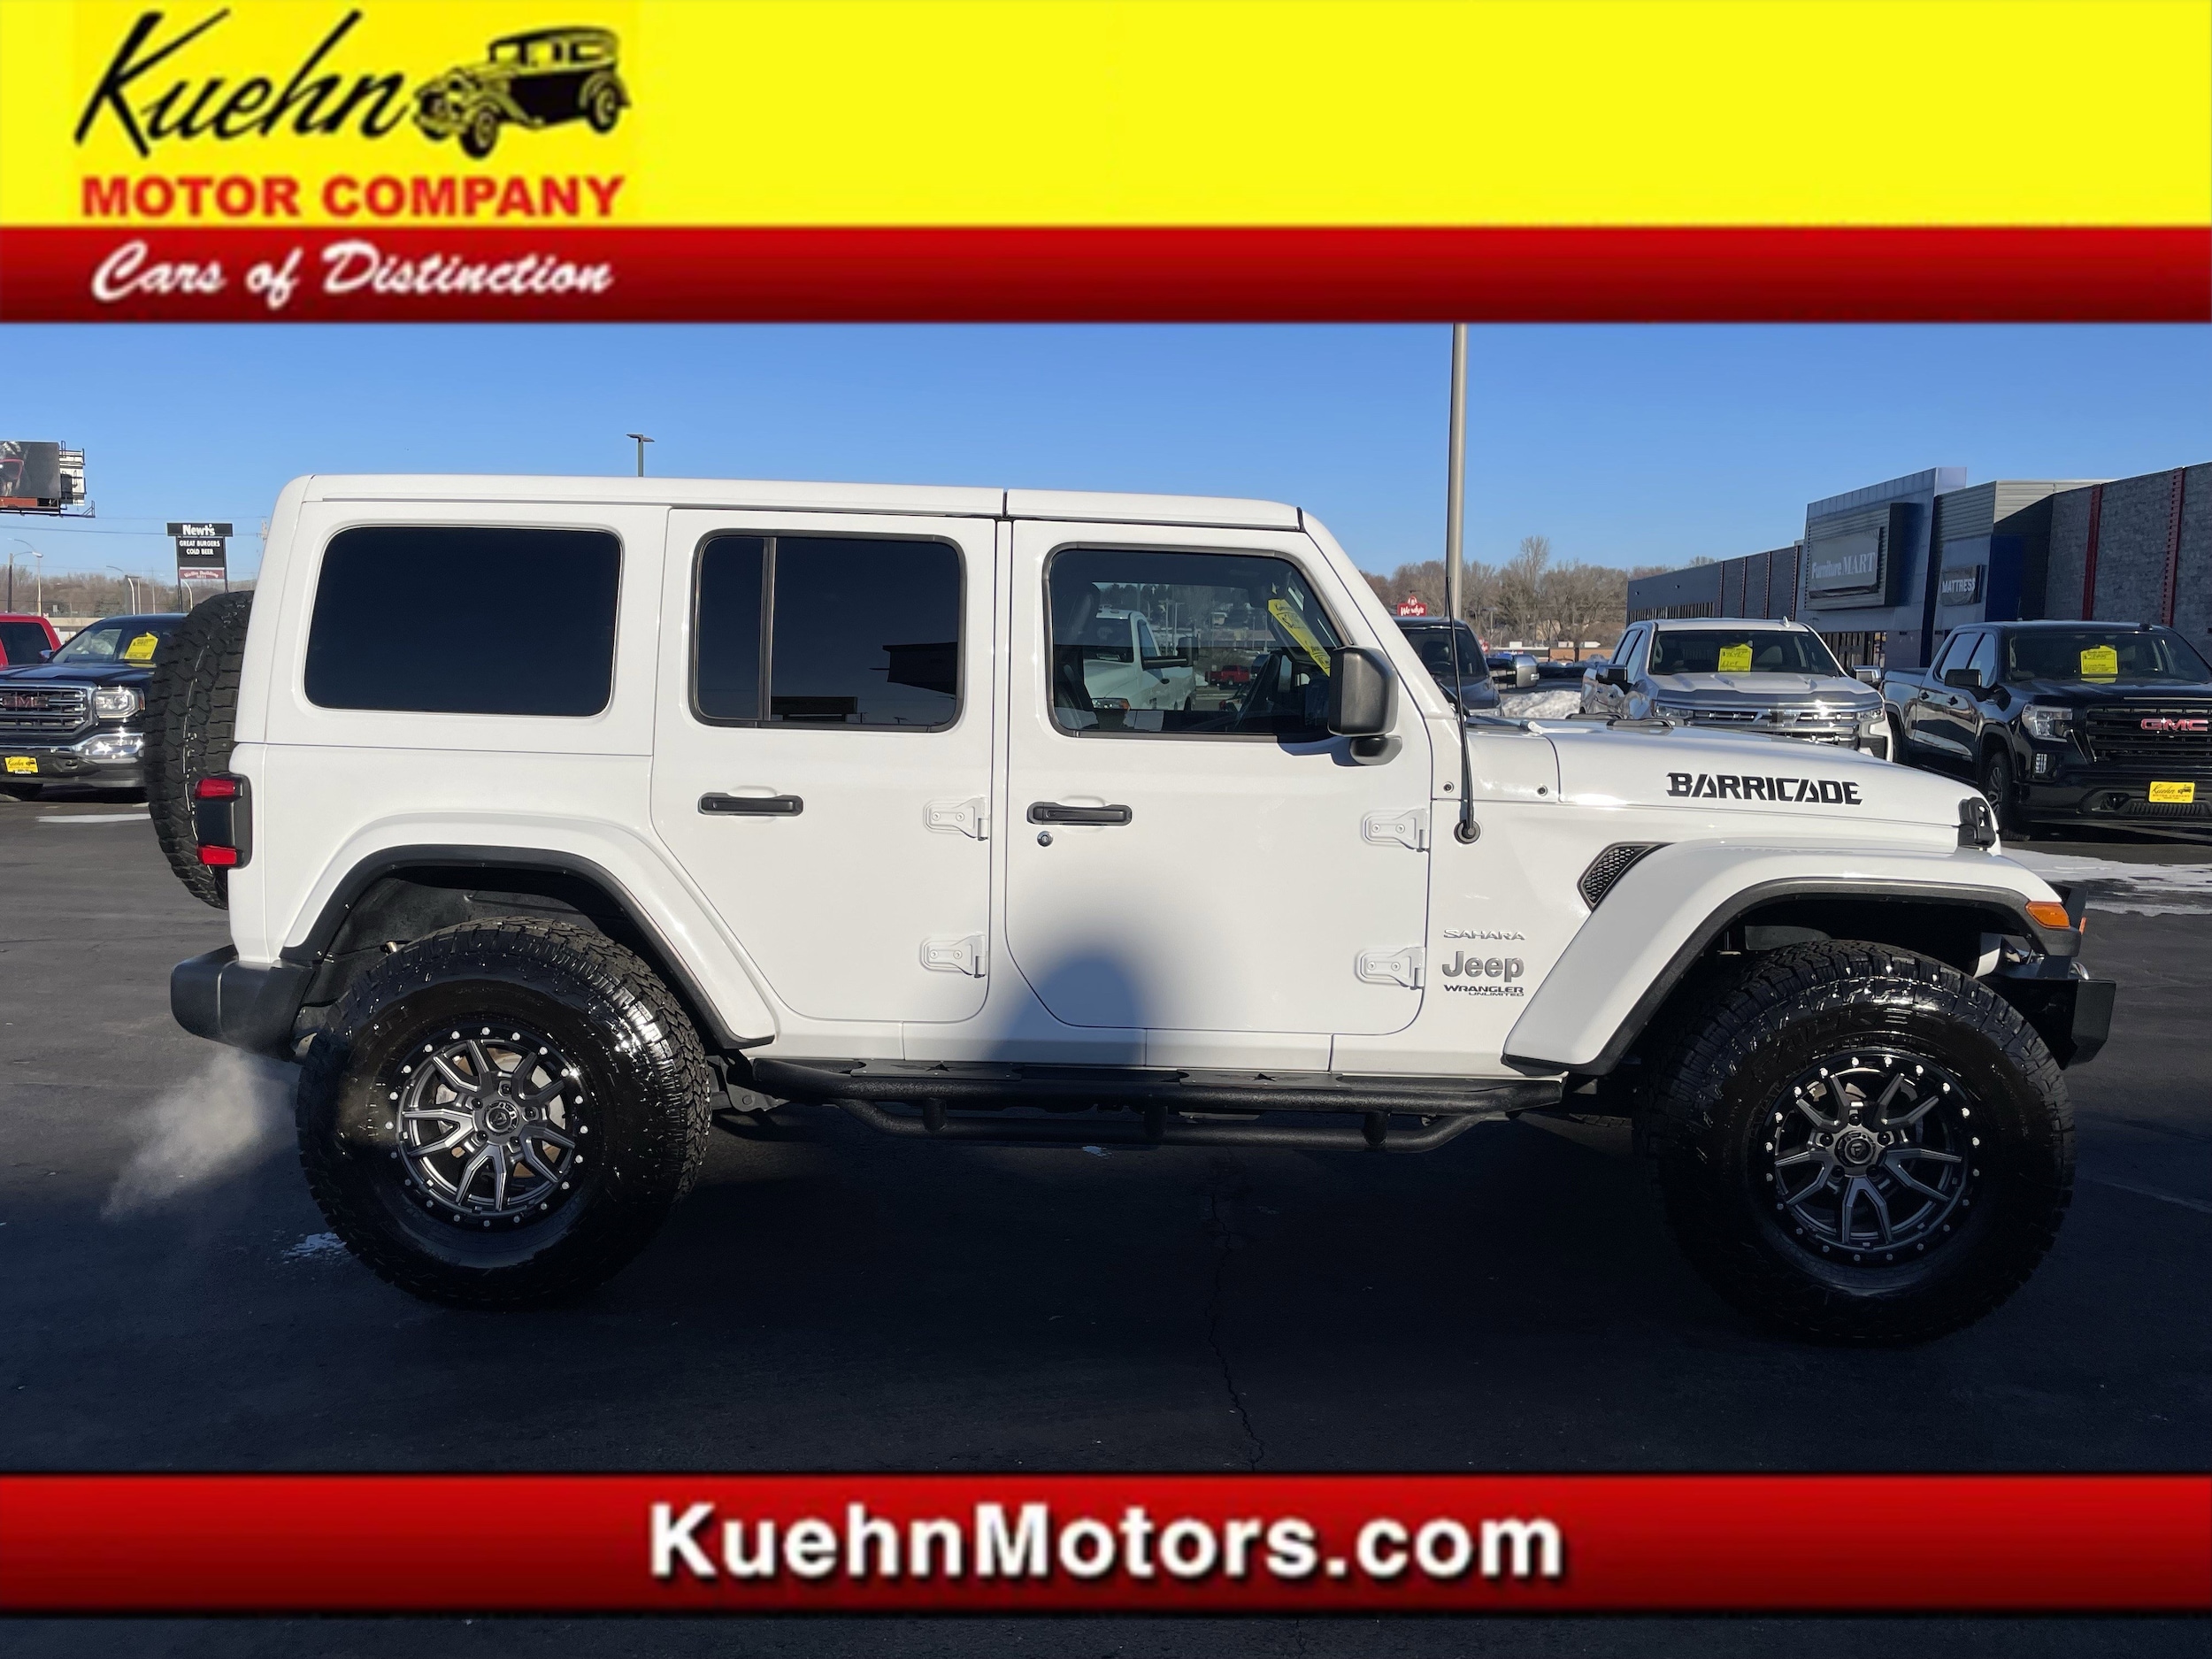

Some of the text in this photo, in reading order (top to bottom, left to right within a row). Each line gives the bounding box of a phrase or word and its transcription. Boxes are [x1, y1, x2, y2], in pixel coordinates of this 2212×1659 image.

[182, 524, 215, 536] Newt's
[1941, 577, 1976, 594] MATTRESS
[1401, 606, 1425, 617] Wendy's
[2141, 718, 2208, 732] GMC
[1665, 772, 1863, 805] BARRICADE
[1443, 929, 1525, 941] SAHARA
[1441, 950, 1525, 983] Jeep
